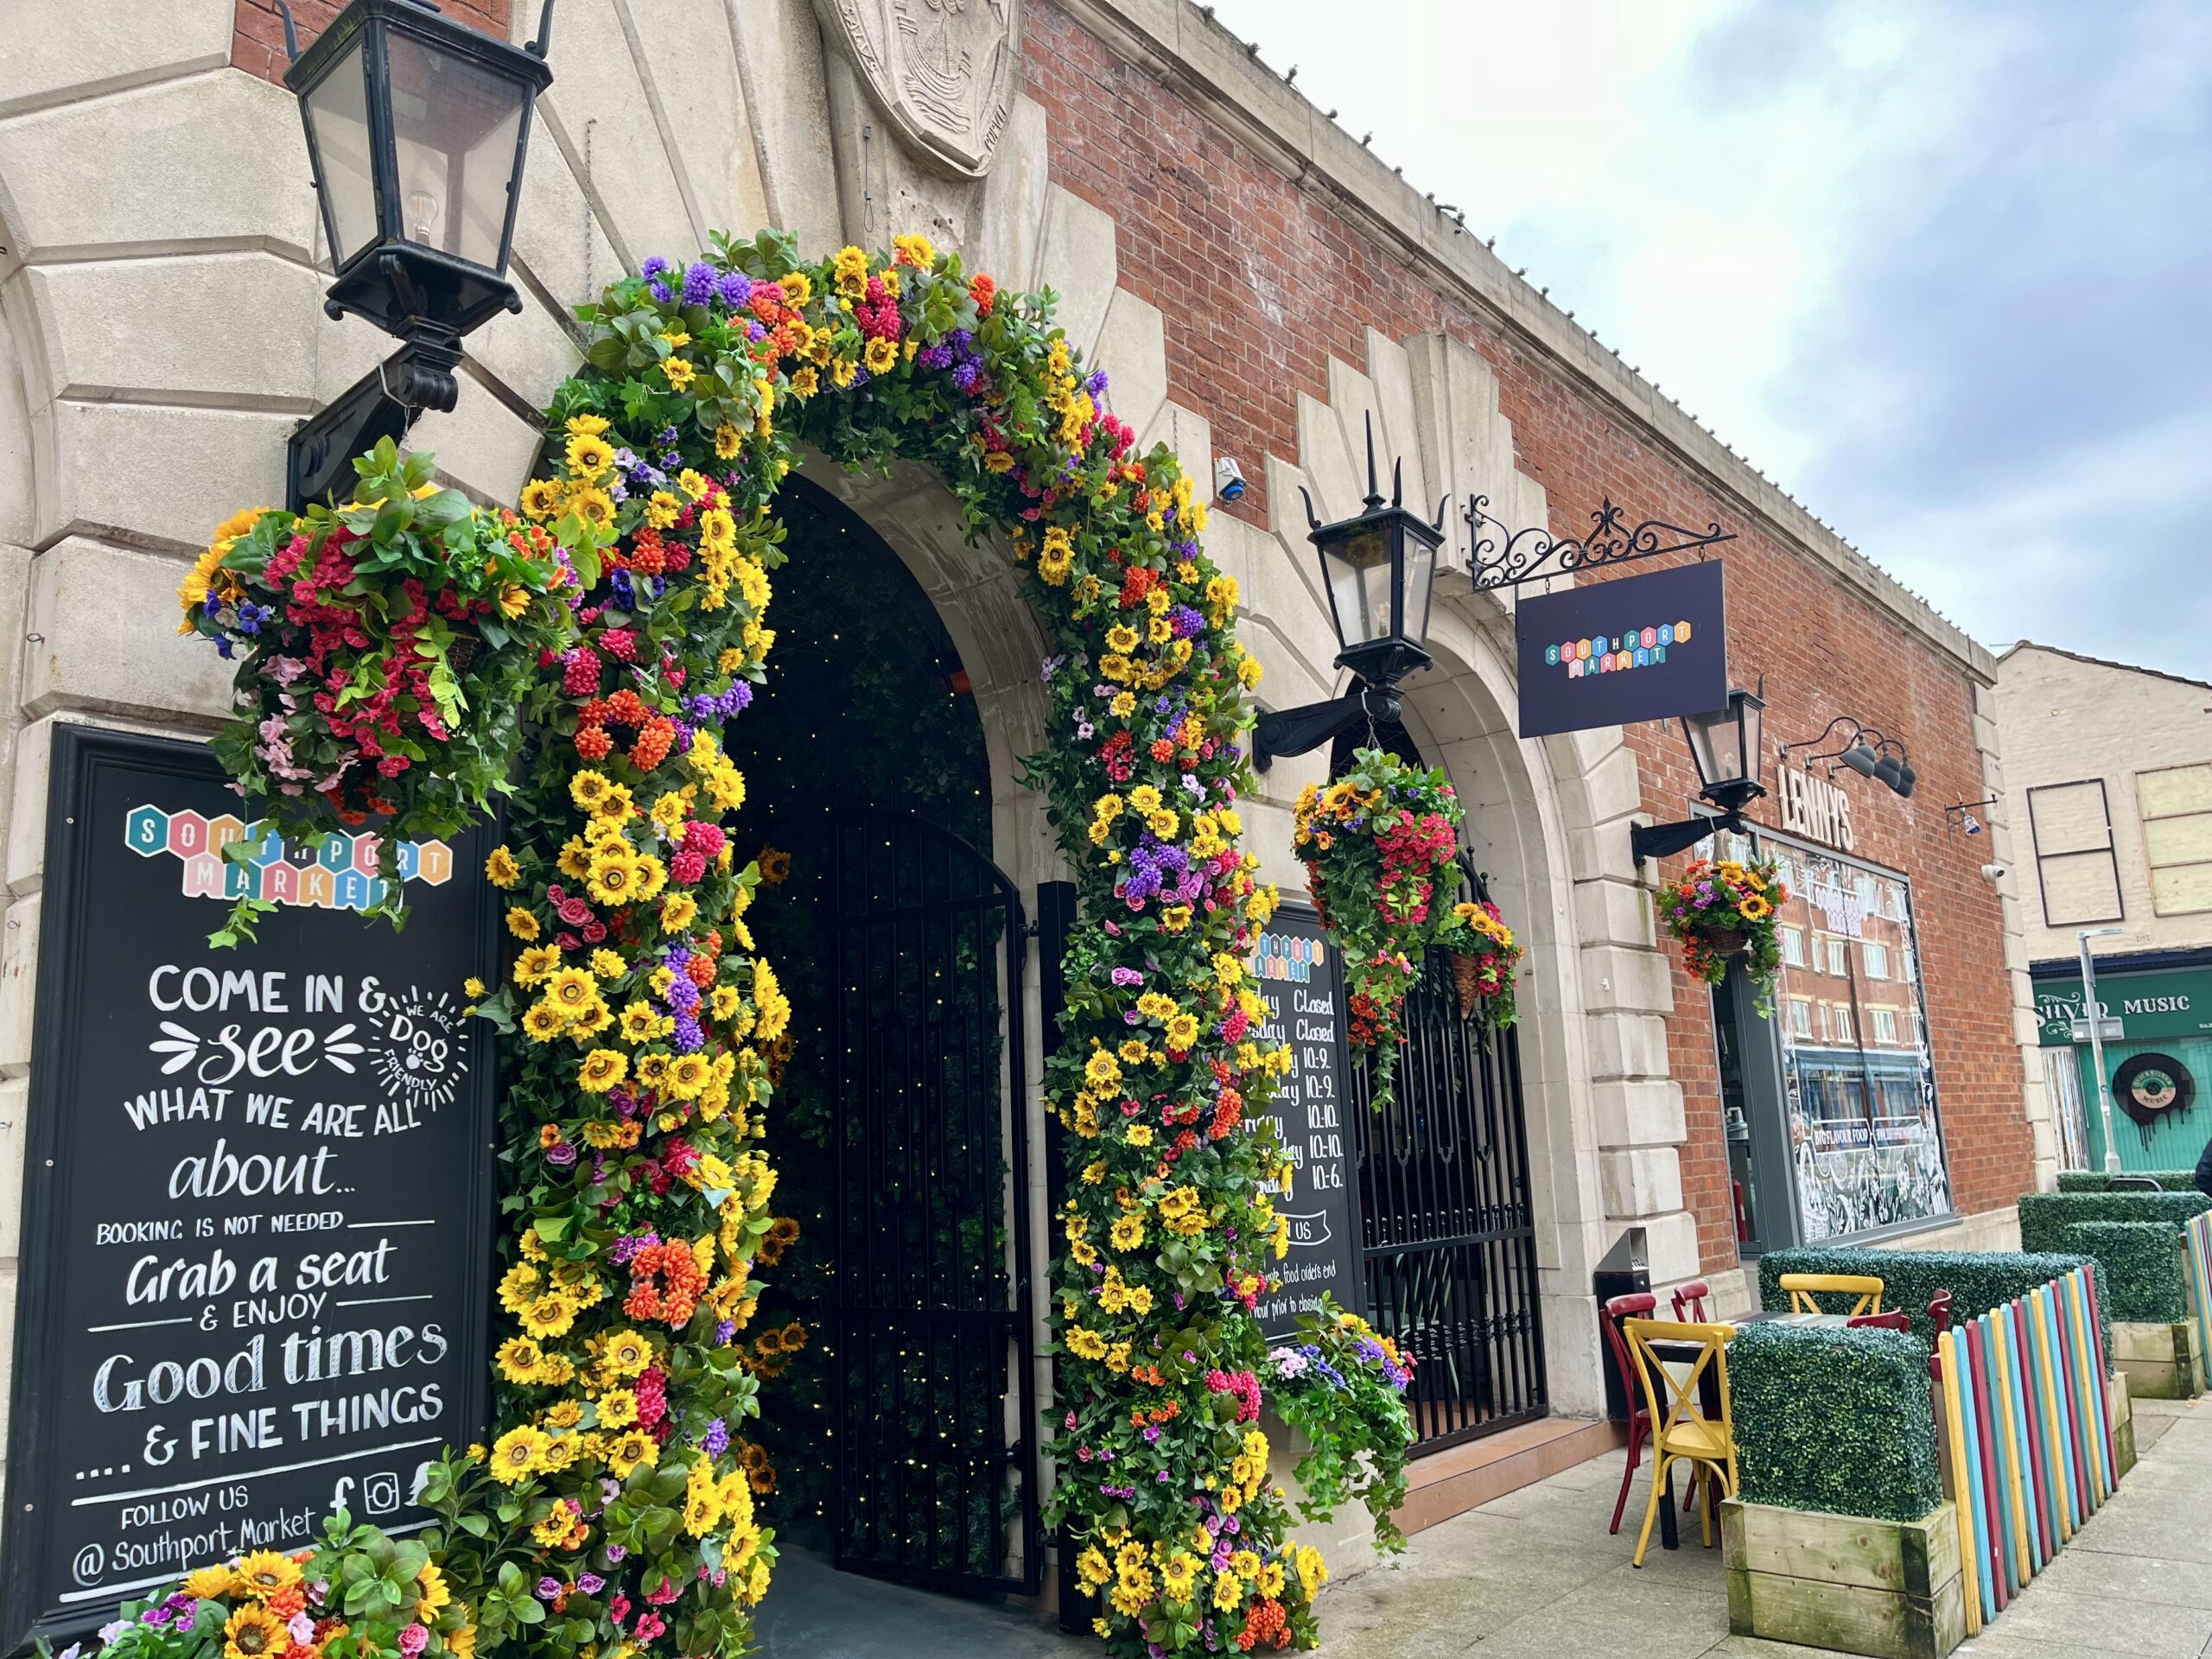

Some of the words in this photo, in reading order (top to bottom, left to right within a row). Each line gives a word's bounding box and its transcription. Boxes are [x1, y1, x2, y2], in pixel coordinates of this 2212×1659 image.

[1549, 626, 1686, 661] SOUTHPORT
[1573, 647, 1662, 673] MARKET
[1777, 764, 1855, 851] LENNYS
[149, 964, 289, 1014] COME
[305, 974, 343, 1014] IN
[359, 976, 386, 1013] &
[1294, 988, 1334, 1015] Closed
[2123, 995, 2190, 1014] MUSIC
[406, 1005, 425, 1016] WE
[429, 1011, 454, 1033] ARE
[1296, 1019, 1335, 1042] Closed
[384, 1049, 437, 1090] FRIENDLY
[124, 1088, 233, 1131] WHAT
[246, 1093, 293, 1128] WE
[301, 1104, 366, 1137] ARE
[373, 1099, 422, 1135] ALL
[1815, 1130, 1827, 1146] BIG
[1852, 1127, 1868, 1142] FOOD
[96, 1217, 182, 1246] BOOKING
[195, 1217, 214, 1237] IS
[224, 1214, 263, 1236] NOT
[270, 1211, 344, 1232] NEEDED
[1296, 1221, 1312, 1240] US
[125, 1249, 236, 1306] Grab
[249, 1255, 277, 1294] a
[296, 1237, 397, 1290] seat
[1283, 1262, 1299, 1284] food
[1300, 1262, 1322, 1281] orders
[1323, 1259, 1337, 1279] end
[199, 1306, 219, 1332] &
[233, 1293, 327, 1328] ENJOY
[1272, 1294, 1287, 1322] prior
[1289, 1295, 1297, 1313] to
[92, 1334, 267, 1414] Good
[281, 1323, 448, 1386] times
[143, 1425, 178, 1467] &
[191, 1407, 283, 1460] FINE
[291, 1382, 444, 1440] THINGS
[122, 1486, 210, 1529] FOLLOW
[219, 1485, 250, 1510] US
[73, 1544, 104, 1586] @
[111, 1519, 233, 1571] Southport
[239, 1507, 317, 1549] Market
